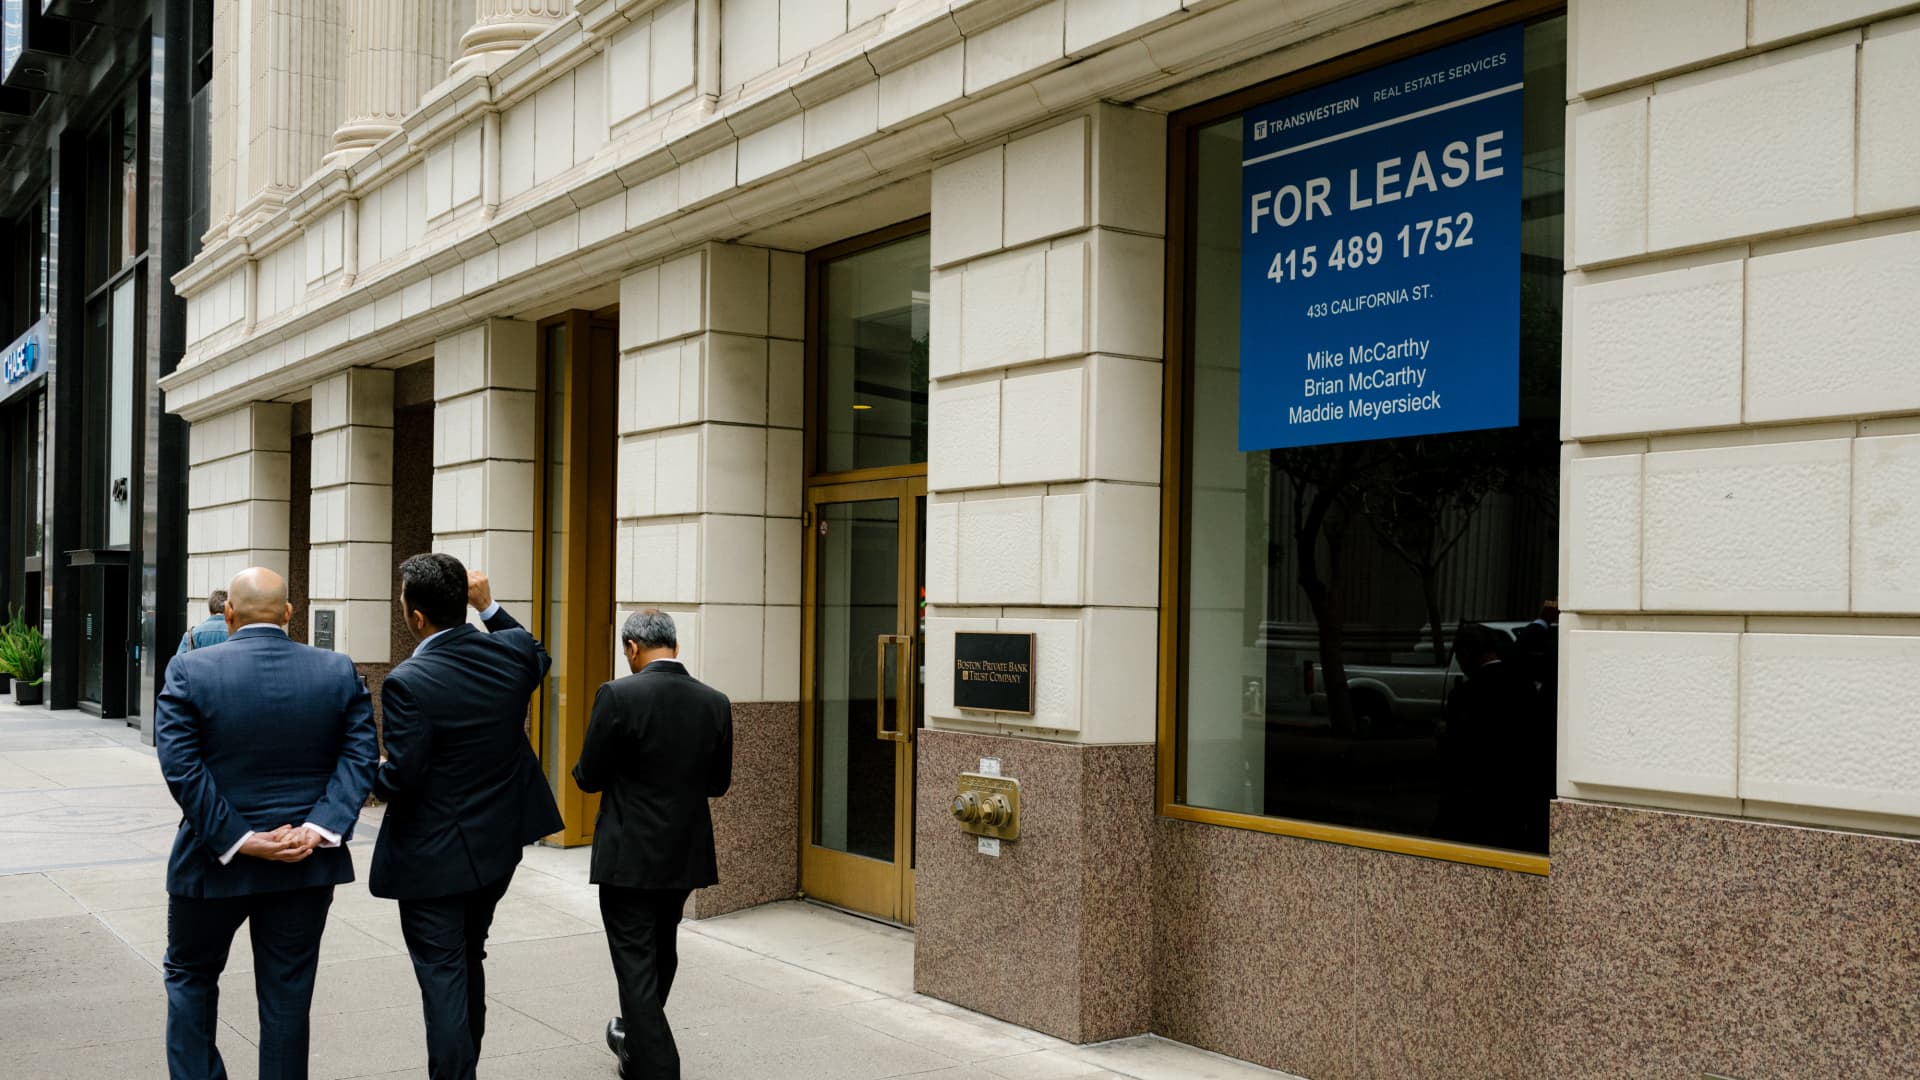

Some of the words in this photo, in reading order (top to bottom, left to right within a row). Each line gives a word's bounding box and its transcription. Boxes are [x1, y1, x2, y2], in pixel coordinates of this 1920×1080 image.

[1269, 96, 1359, 133] TRANSWESTERN
[1373, 85, 1402, 102] REAL
[1404, 71, 1445, 93] ESTATE
[1448, 53, 1507, 80] SERVICES
[1251, 177, 1332, 234] FOR
[1350, 130, 1504, 211] LEASE
[1267, 246, 1317, 283] 415
[1328, 232, 1383, 271] 489
[1398, 212, 1473, 258] 1752
[1307, 302, 1328, 318] 433
[1331, 288, 1409, 314] CALIFORNIA
[1412, 284, 1433, 300] ST.
[4, 343, 27, 383] CHASE
[1307, 350, 1343, 371] Mike
[1349, 337, 1430, 365] McCarthy
[1304, 377, 1343, 397] Brian
[1349, 366, 1427, 392] McCarthy
[1289, 402, 1343, 424] Maddie
[1348, 390, 1441, 420] Meyersieck
[1008, 661, 1028, 672] BANK
